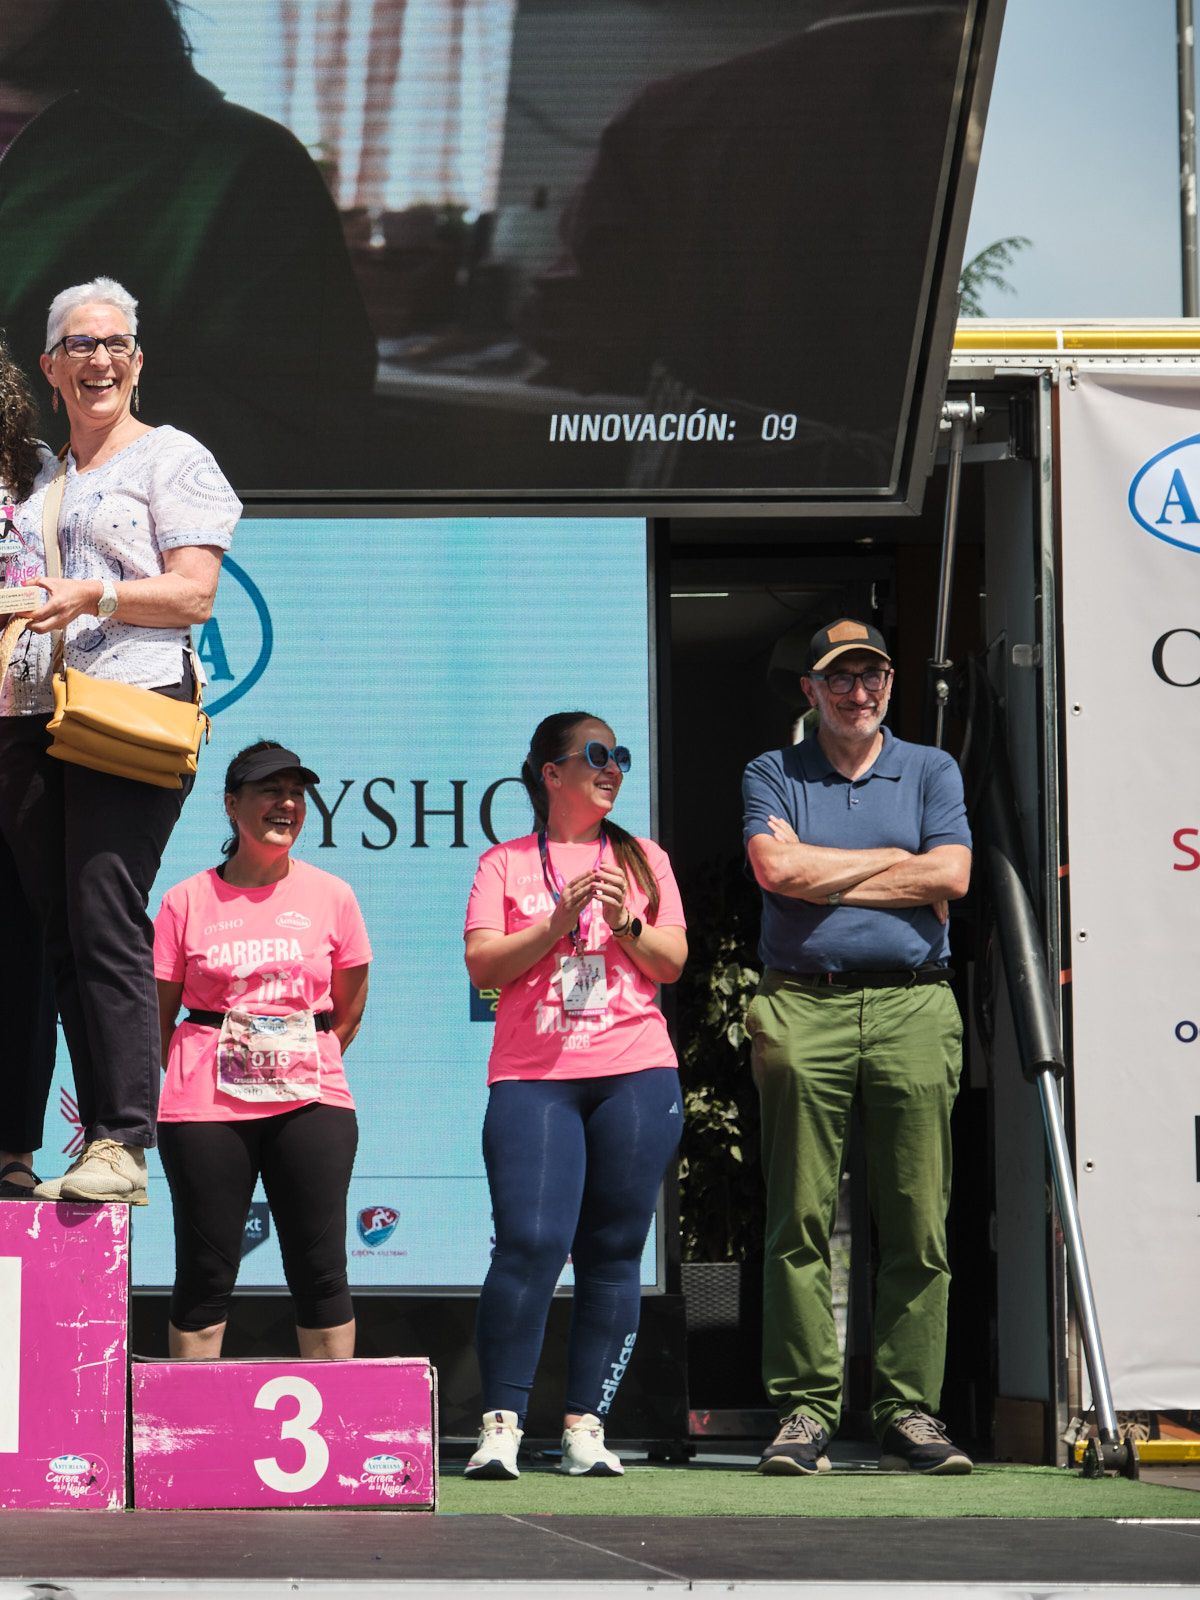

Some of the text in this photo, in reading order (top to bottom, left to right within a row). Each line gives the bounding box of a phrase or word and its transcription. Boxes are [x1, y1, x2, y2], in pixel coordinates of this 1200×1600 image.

[549, 409, 798, 442] INNOVACIÓN: 09
[204, 918, 244, 936] OYSHO
[207, 938, 304, 970] CARRERA
[562, 1034, 590, 1050] 2026
[252, 1051, 291, 1068] 016
[254, 1376, 330, 1493] 3
[46, 1472, 79, 1483] Carrera
[360, 1473, 394, 1484] Carrera
